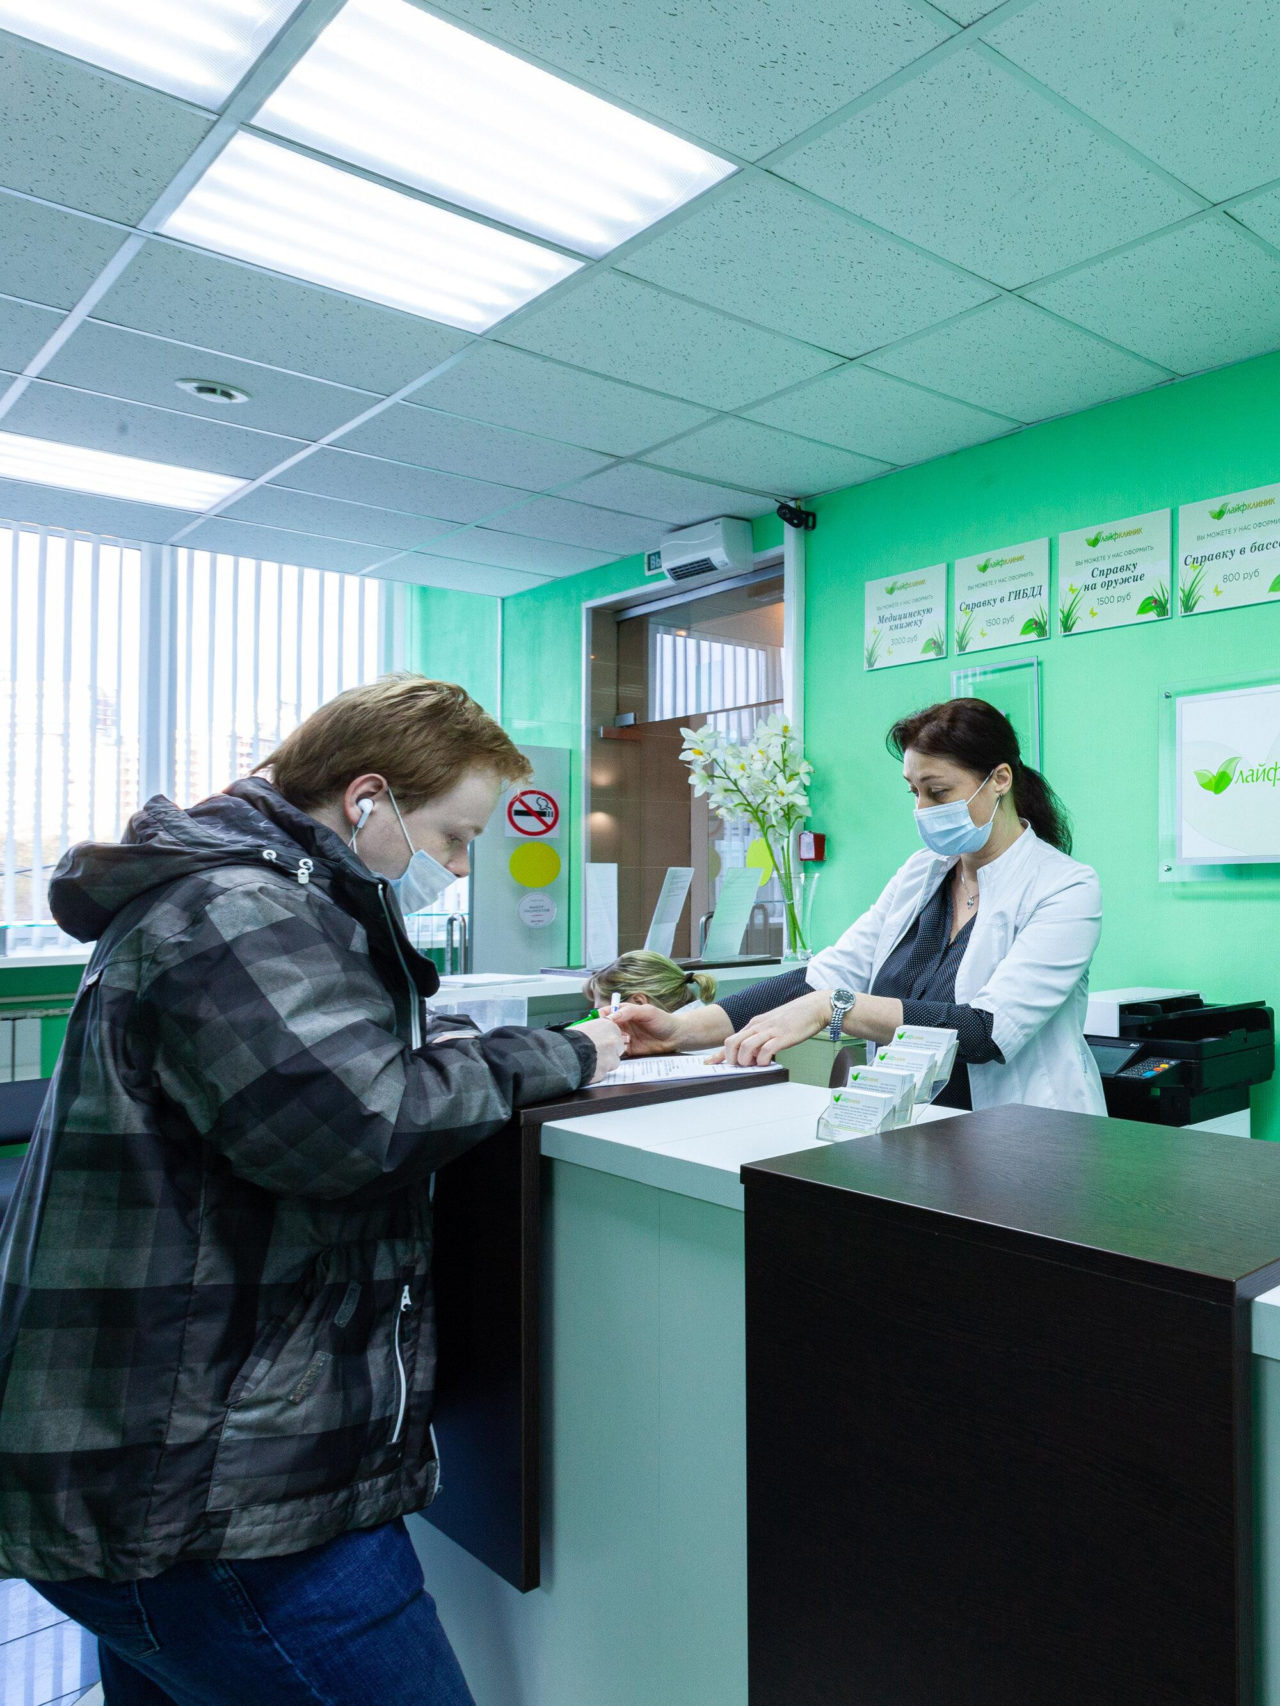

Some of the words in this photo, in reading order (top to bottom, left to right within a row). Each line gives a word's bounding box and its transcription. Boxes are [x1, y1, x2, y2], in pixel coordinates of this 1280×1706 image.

[1206, 528, 1231, 539] МОЖЕТЕ
[1184, 548, 1236, 566] Справку
[1239, 546, 1246, 555] в
[1091, 562, 1138, 578] Справку
[1222, 572, 1241, 583] 800
[1243, 568, 1260, 581] руб
[1084, 582, 1097, 591] на
[1100, 573, 1145, 590] оружие
[960, 597, 997, 612] Справку
[1008, 585, 1043, 601] ГИБДД
[1097, 595, 1115, 605] 1500
[1117, 592, 1131, 604] руб
[877, 607, 933, 624] Медицинскую
[889, 619, 923, 631] книжку
